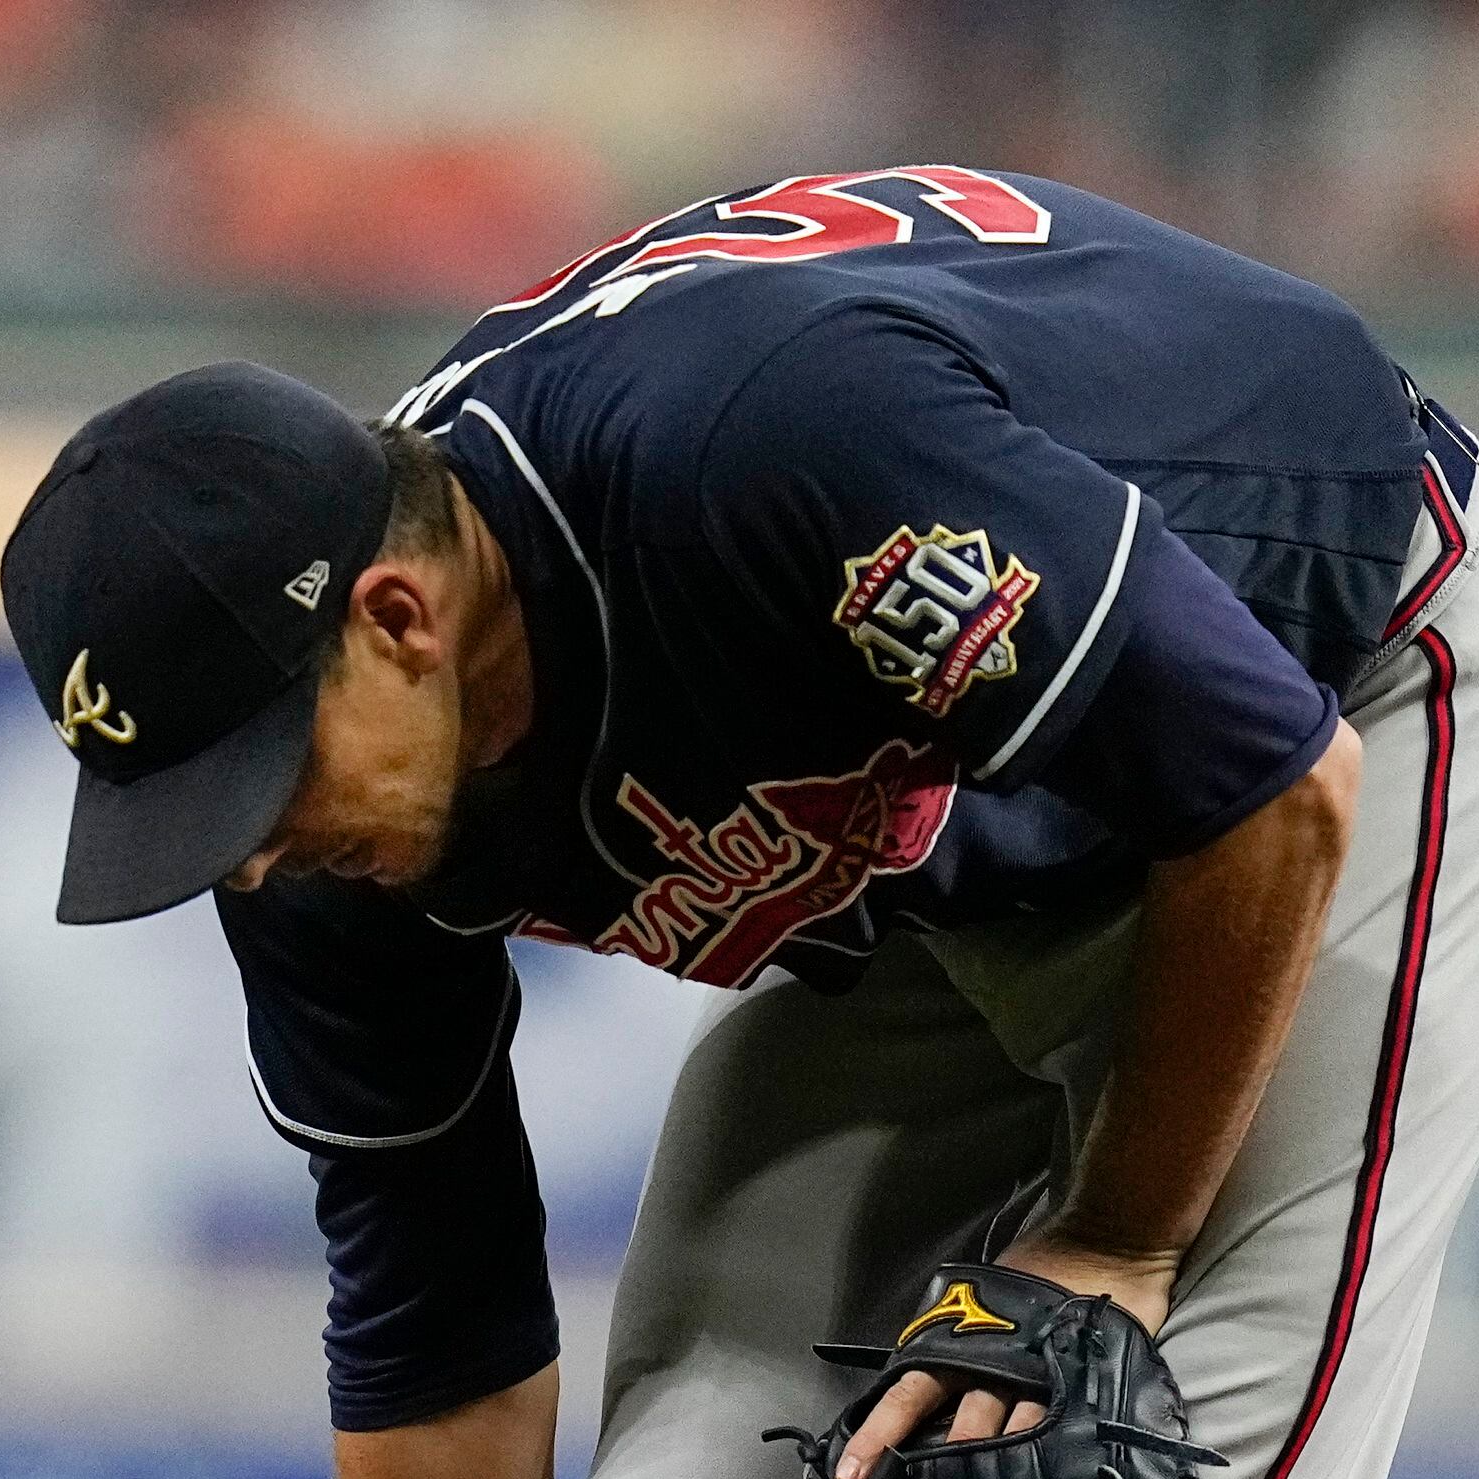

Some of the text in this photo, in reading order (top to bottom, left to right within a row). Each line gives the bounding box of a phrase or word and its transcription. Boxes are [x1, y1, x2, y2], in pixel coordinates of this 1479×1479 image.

[847, 544, 907, 618] BRAVES
[855, 542, 991, 679] 150
[944, 604, 1008, 688] ANNIVERSARY
[53, 648, 137, 747] A
